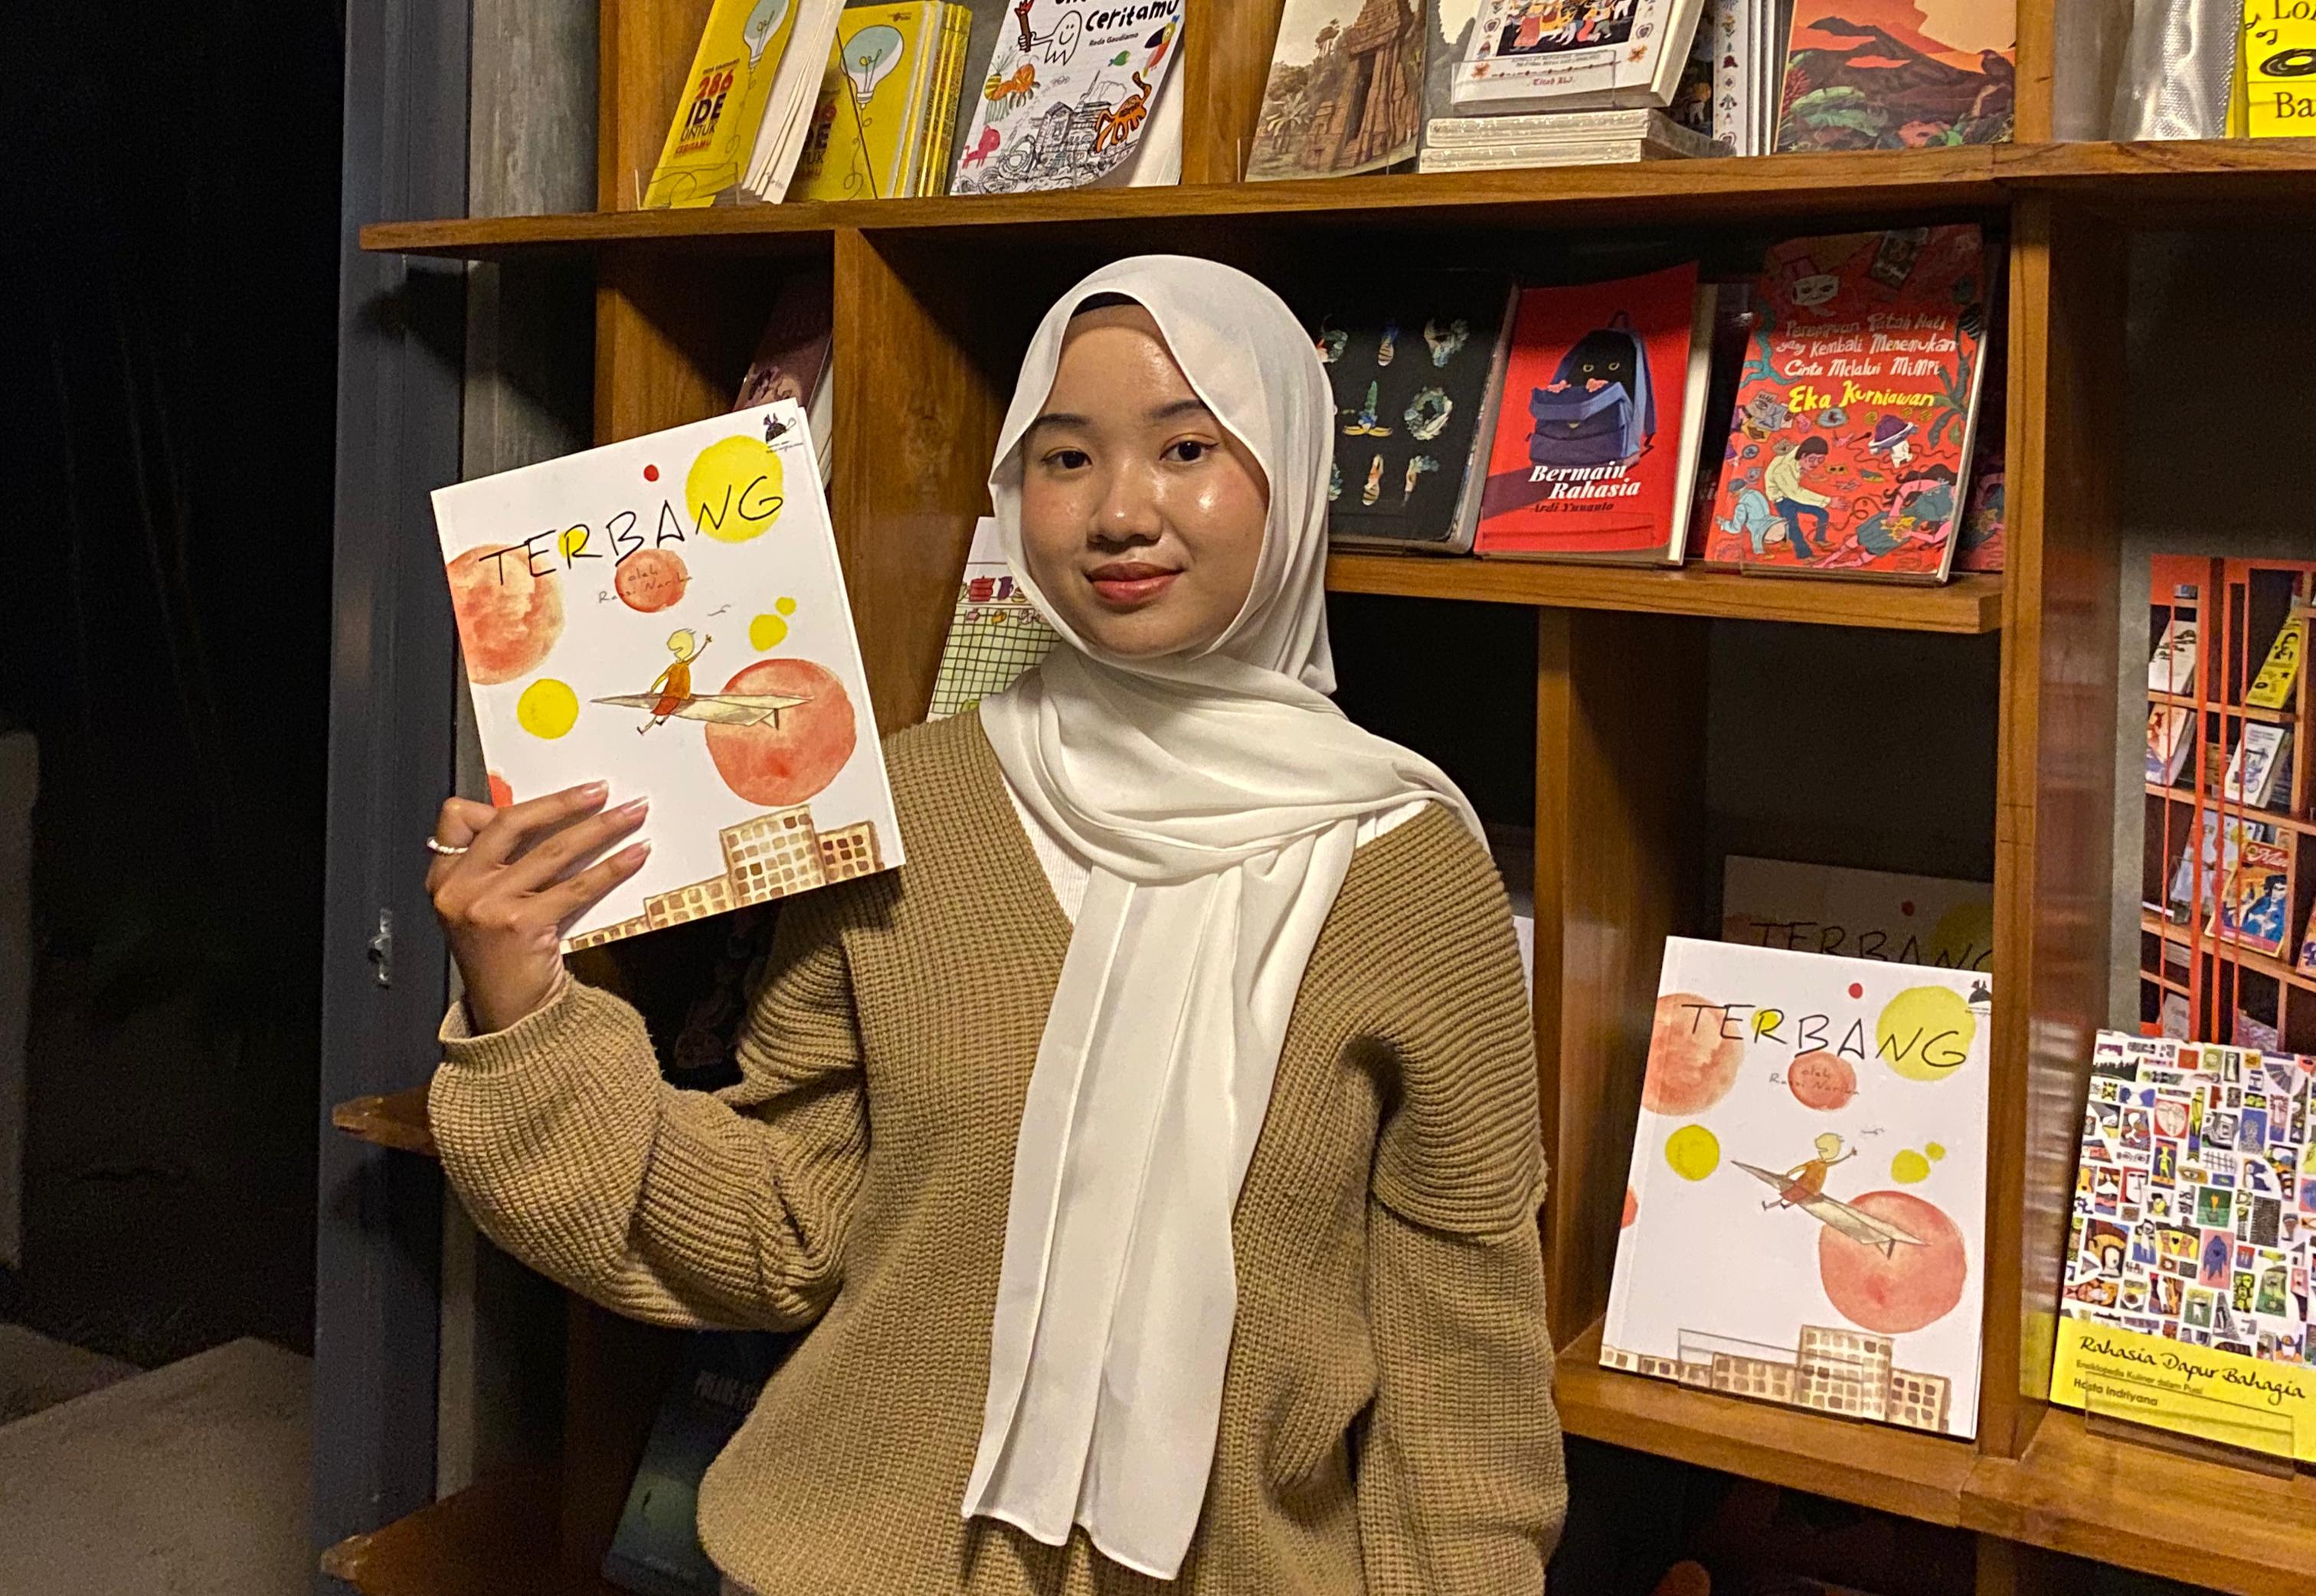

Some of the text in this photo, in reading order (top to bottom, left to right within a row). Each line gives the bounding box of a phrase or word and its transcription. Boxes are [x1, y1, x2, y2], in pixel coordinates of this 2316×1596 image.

[695, 68, 734, 100] 286
[685, 92, 727, 128] IDE
[680, 122, 718, 142] UNTUK
[1785, 319, 1860, 338] Perempuan
[1867, 312, 1912, 332] Patah
[1810, 335, 1863, 358] Kembali
[1869, 333, 1957, 355] Menemukan
[1784, 358, 1823, 377] Cinta
[1827, 358, 1882, 377] Melalui
[1788, 380, 1935, 414] Eka Kurniawan
[1528, 460, 1627, 482] Bermain
[1548, 478, 1641, 500] Rahasia
[479, 475, 784, 586] TERBANG
[1681, 1003, 1968, 1068] TERBANG
[2079, 1336, 2306, 1406] Rahasia Dapur Bahagia
[2074, 1378, 2158, 1406] Hasta Indriyana
